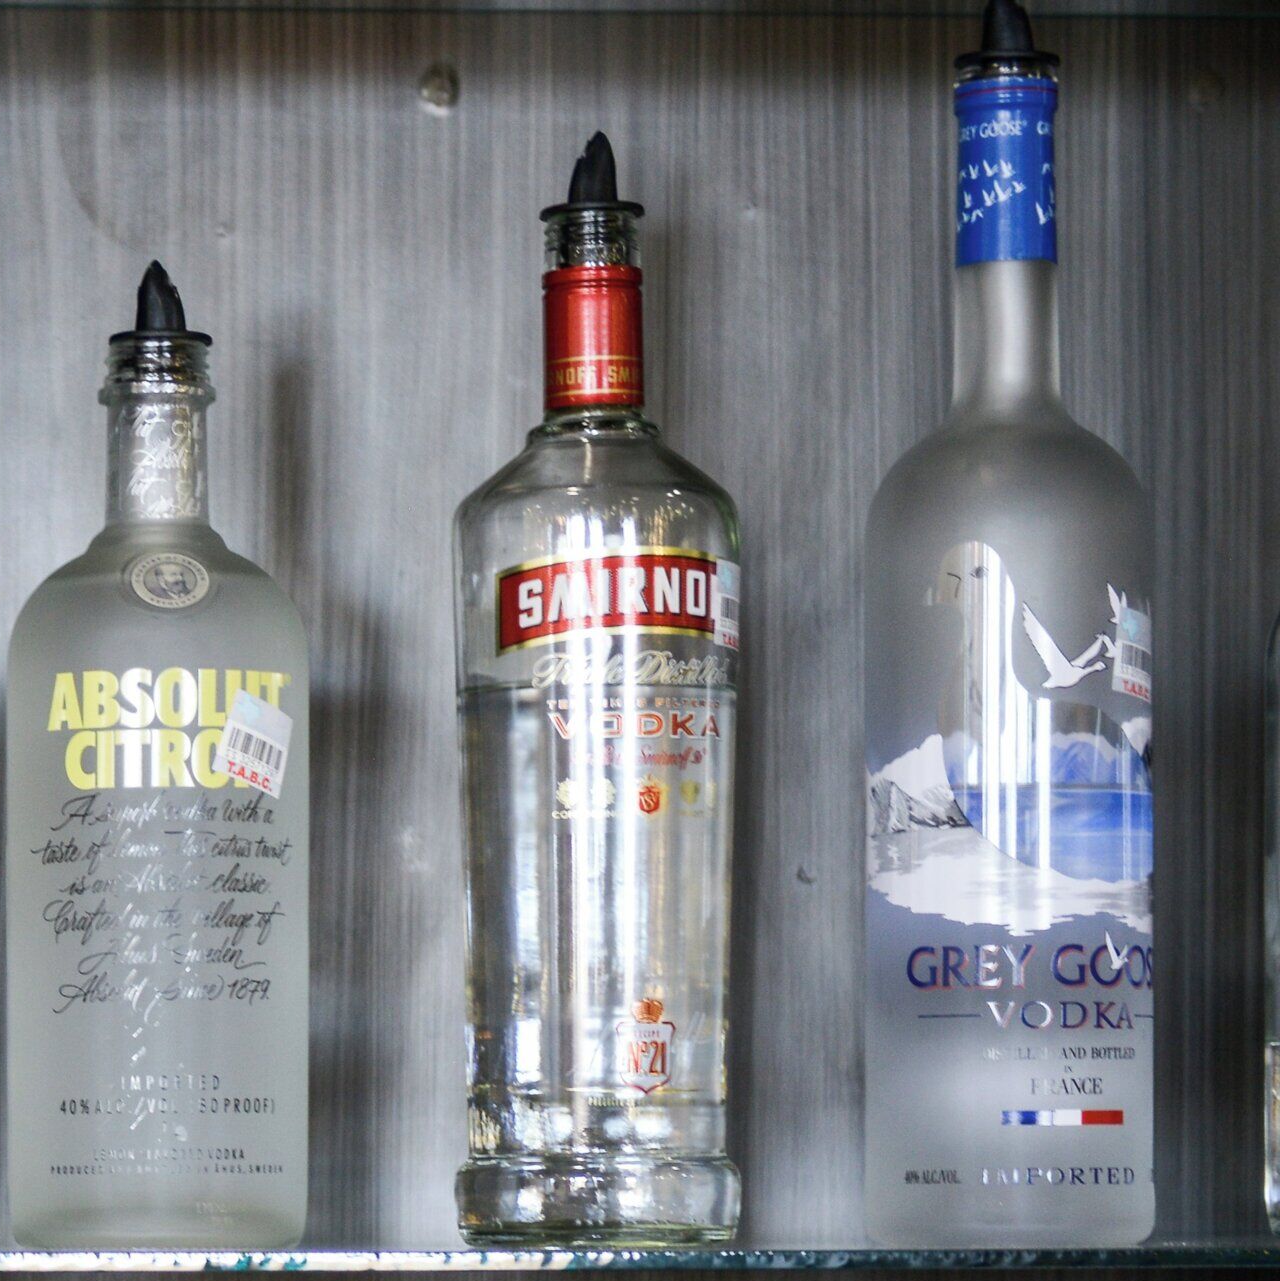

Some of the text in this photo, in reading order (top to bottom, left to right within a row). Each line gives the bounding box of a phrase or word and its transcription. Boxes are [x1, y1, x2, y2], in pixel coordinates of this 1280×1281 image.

[979, 120, 1023, 139] GOOSE
[548, 710, 721, 740] VODKA
[227, 760, 272, 792] T.A.B.C.
[906, 943, 1032, 990] GREY
[986, 1001, 1134, 1029] VODKA
[1060, 1047, 1087, 1060] AND
[1090, 1047, 1135, 1060] BOTTLED
[1031, 1077, 1103, 1095] FRANCE
[60, 1100, 276, 1115] 40% PROOF)
[981, 1166, 1135, 1186] IMPORTED
